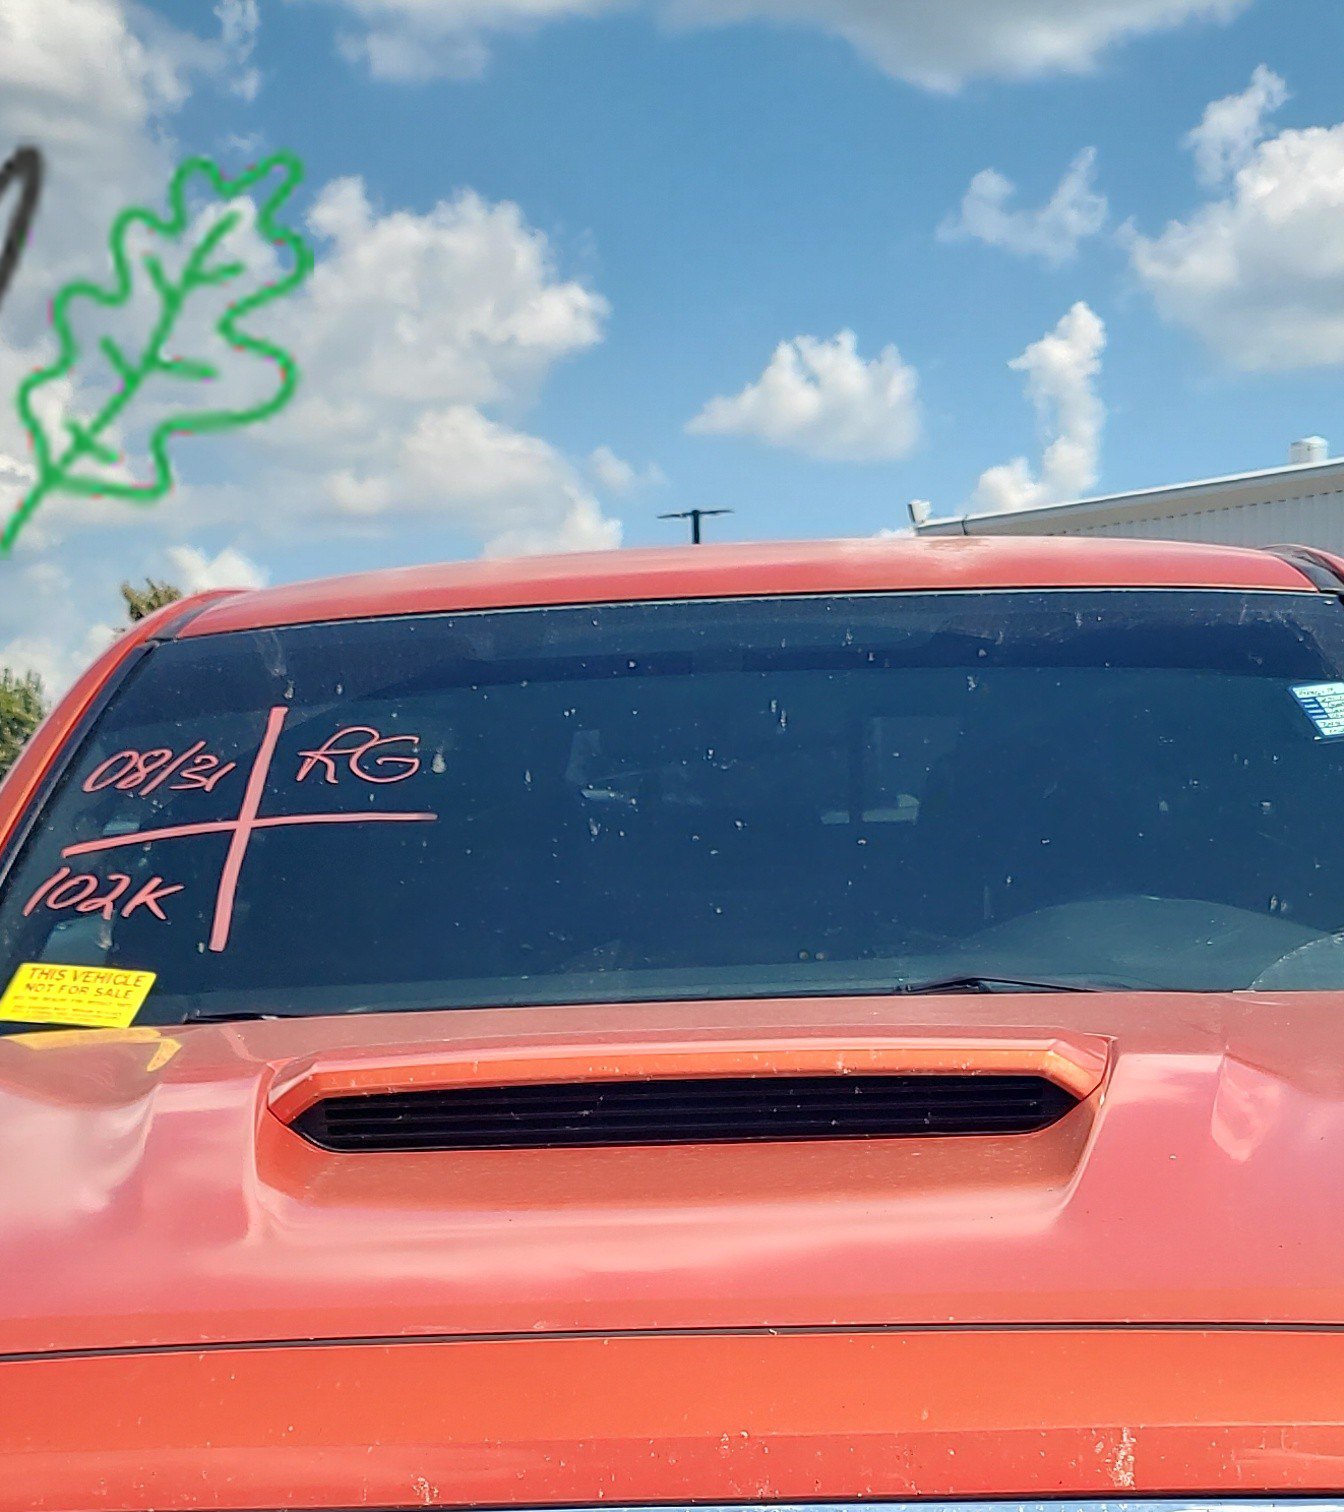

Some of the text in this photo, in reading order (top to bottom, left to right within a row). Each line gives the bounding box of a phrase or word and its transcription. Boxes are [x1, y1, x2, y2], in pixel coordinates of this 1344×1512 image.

[82, 741, 237, 797] 08/31
[22, 866, 186, 921] 102K
[25, 983, 134, 1000] NOT FOR SALE
[30, 967, 147, 988] THIS VEHICLE
